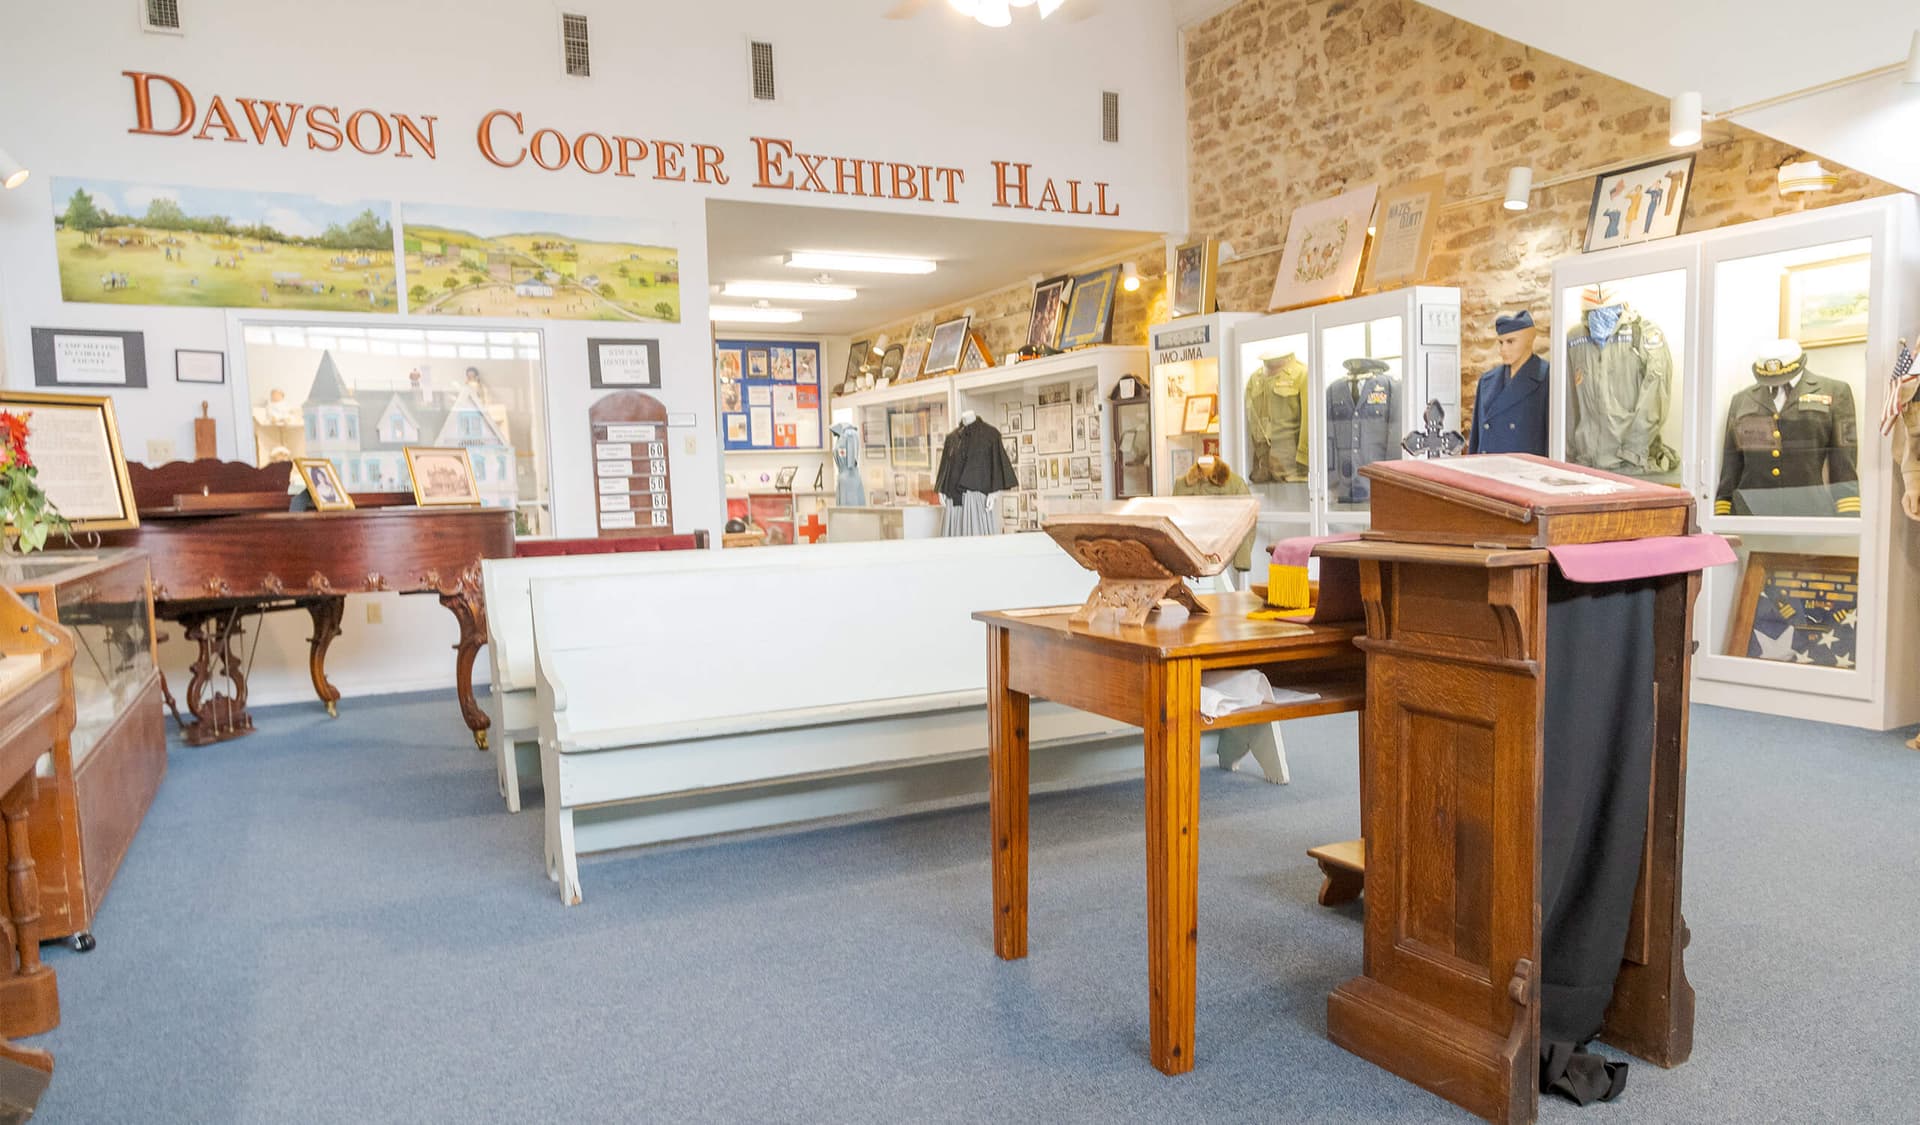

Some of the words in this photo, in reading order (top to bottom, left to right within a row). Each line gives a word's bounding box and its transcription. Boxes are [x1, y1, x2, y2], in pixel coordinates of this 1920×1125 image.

[122, 70, 438, 159] DAWSON
[477, 109, 730, 185] COOPER
[750, 136, 965, 203] EXHIBIT
[991, 160, 1120, 216] HALL
[1160, 350, 1178, 365] IWO
[1180, 346, 1203, 362] JIMA
[650, 445, 663, 454] 60
[652, 461, 665, 472] 55
[650, 478, 663, 489] 50
[654, 495, 666, 506] 60
[655, 512, 665, 523] 15
